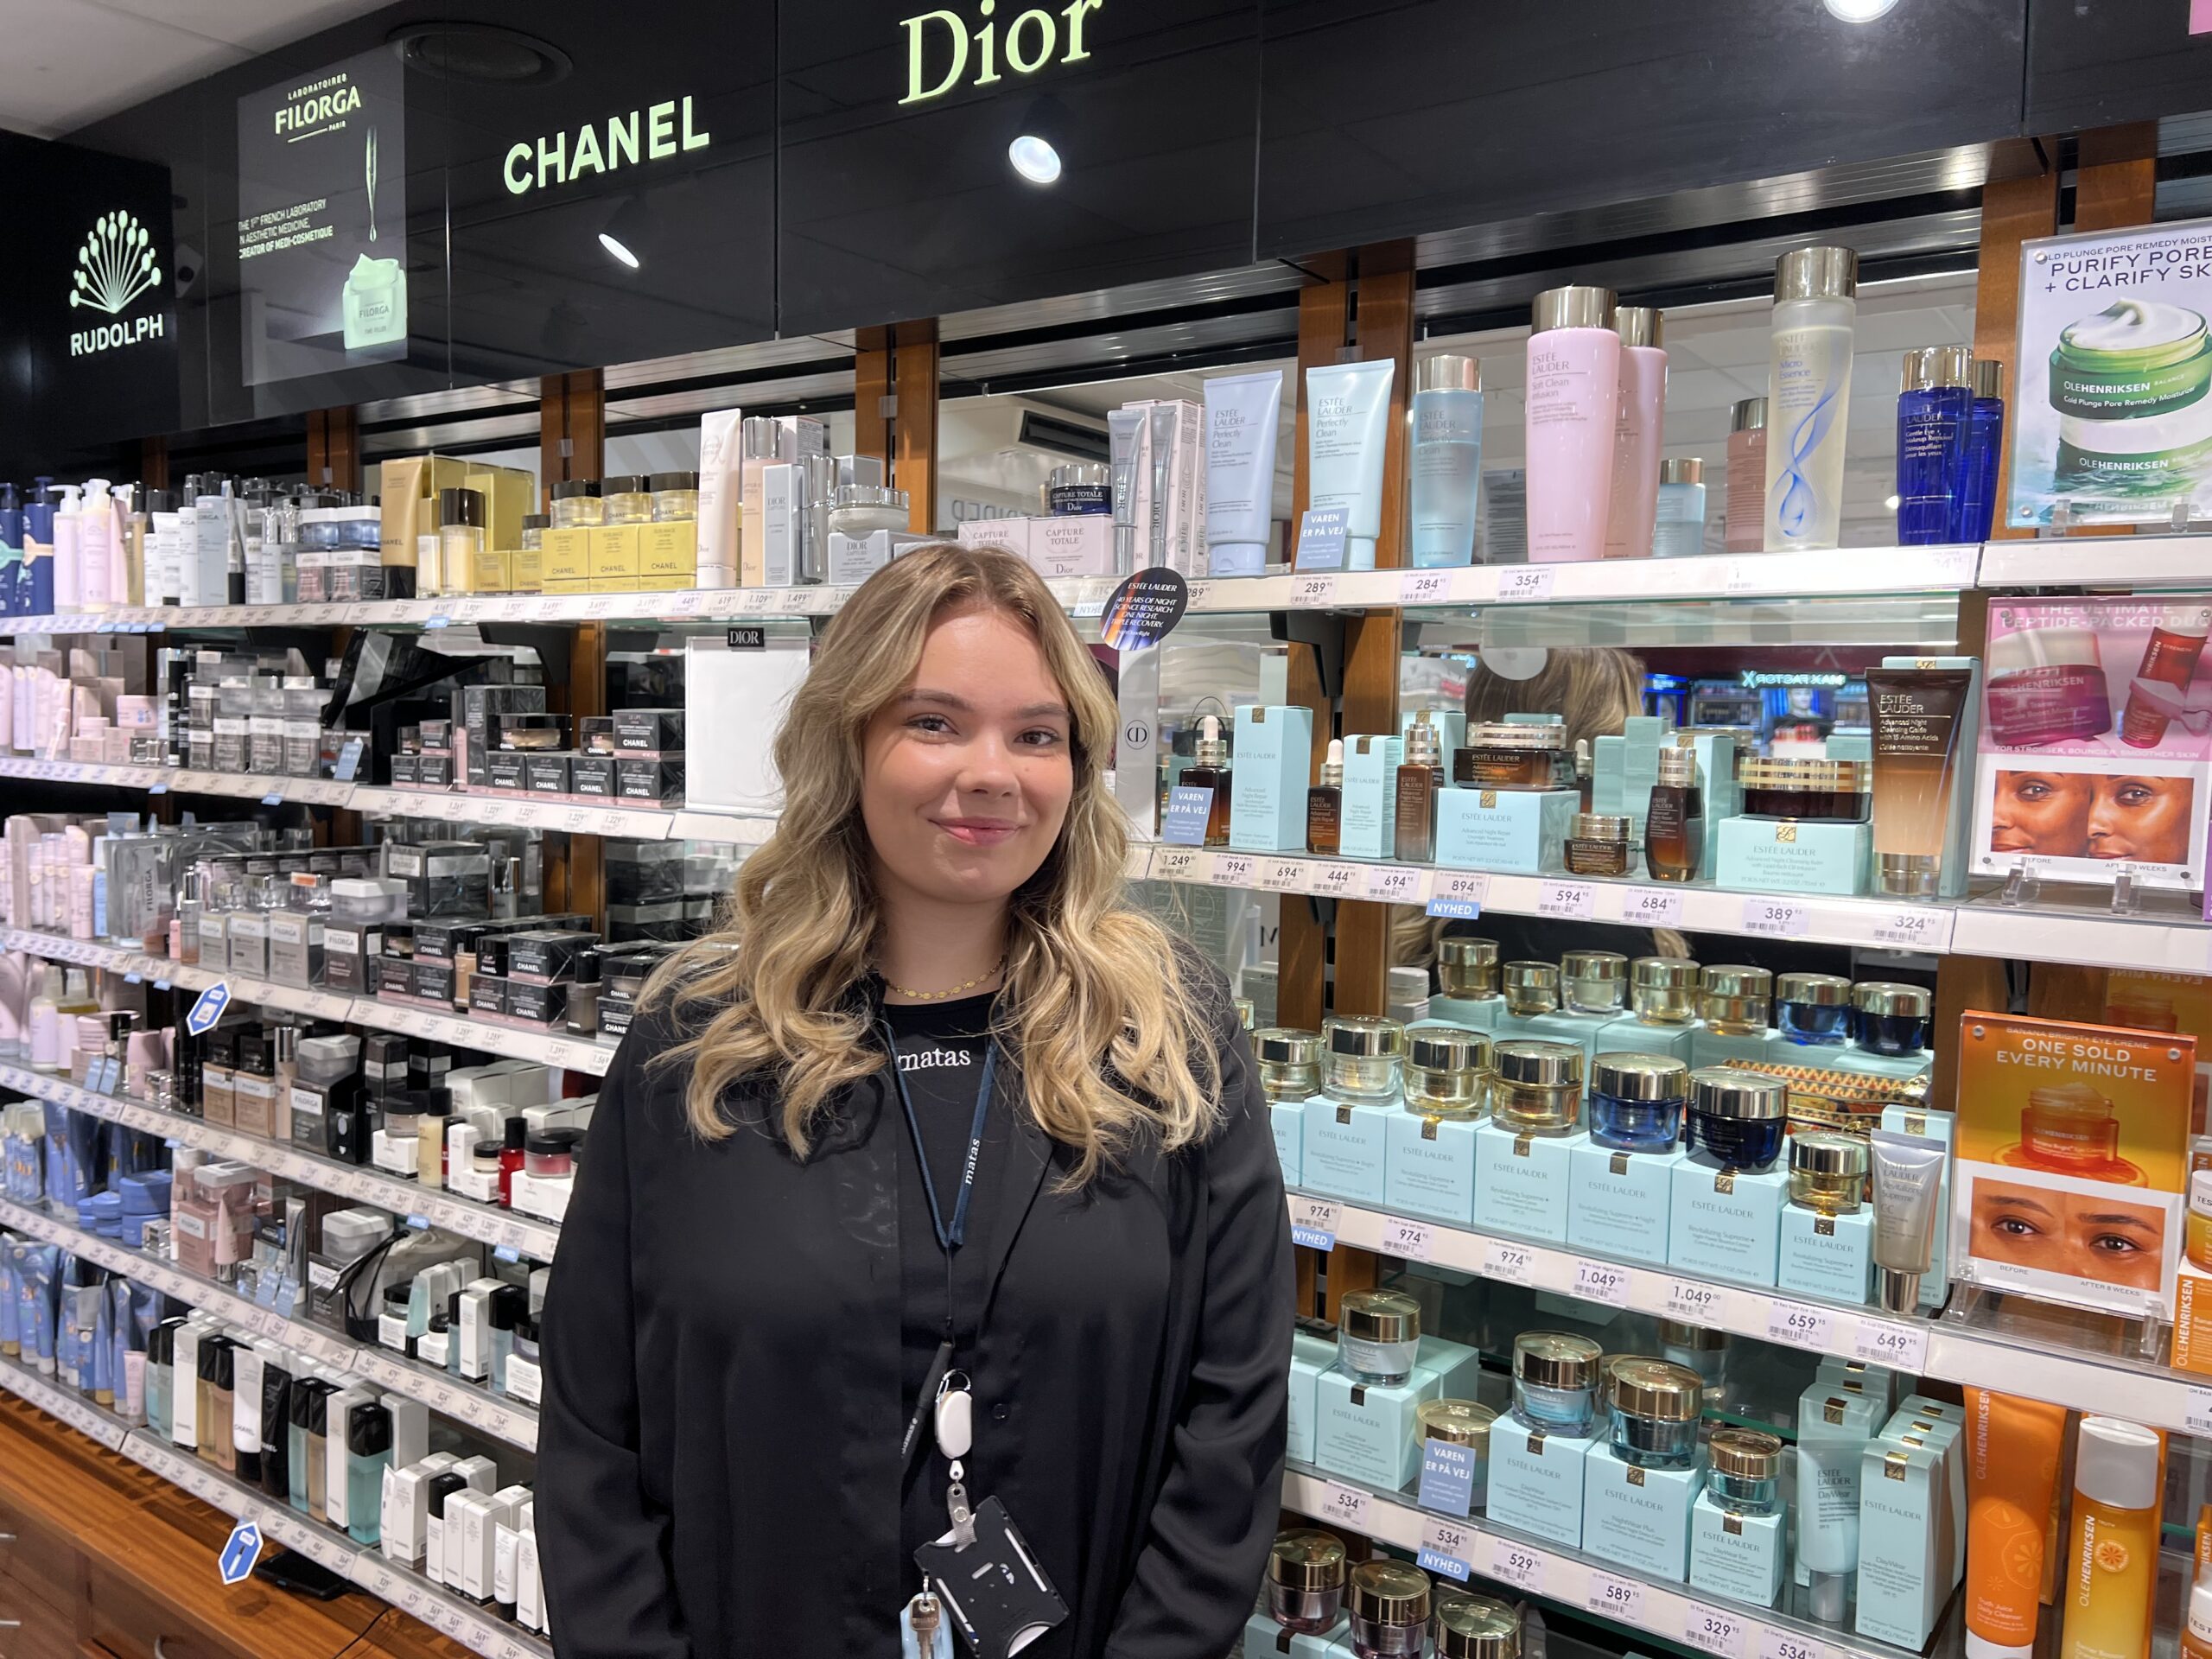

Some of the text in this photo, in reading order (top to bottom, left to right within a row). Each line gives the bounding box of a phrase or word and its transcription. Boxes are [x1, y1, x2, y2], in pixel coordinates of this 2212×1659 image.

[898, 0, 1103, 105] Dior
[288, 73, 347, 100] LABORATOIRES
[275, 86, 361, 134] FILORGA
[504, 96, 710, 194] CHANEL
[266, 241, 274, 252] OF
[275, 226, 334, 250] MEDI-COSMETIQUE
[2063, 248, 2103, 258] PLUNGE
[2107, 245, 2133, 254] PORE
[2136, 239, 2178, 251] REMEDY
[2051, 253, 2140, 276] PURIFY
[2065, 267, 2171, 291] CLARIFY
[359, 304, 390, 319] FILORGA
[70, 314, 163, 356] RUDOLPH
[2063, 396, 2077, 404] Cold
[2078, 397, 2102, 409] Plunge
[2125, 397, 2158, 407] Remedy
[2158, 385, 2196, 402] Moisturizer
[1318, 405, 1352, 416] LAUDER
[1214, 416, 1245, 427] LAUDER
[1317, 417, 1348, 429] Perfectly
[1213, 429, 1242, 439] Perfectly
[1315, 429, 1337, 438] Clean
[1211, 439, 1231, 448] Clean
[2079, 457, 2168, 471] OLEHENRIKSEN
[767, 496, 786, 506] DIOR
[1311, 513, 1339, 524] VAREN
[974, 531, 1009, 539] CAPTURE
[1046, 528, 1084, 537] CAPTURE
[1302, 526, 1344, 537] ER PÅ VEJ
[847, 542, 868, 550] DIOR
[1051, 536, 1079, 545] TOTALE
[651, 562, 677, 570] CHANEL
[1056, 563, 1073, 575] Dior
[1148, 583, 1177, 592] LAUDER
[1305, 582, 1326, 593] 289
[1415, 579, 1438, 590] 284
[1515, 575, 1540, 588] 354
[1140, 604, 1173, 613] RESEARCH
[2039, 604, 2174, 615] THE ULTIMATE
[2001, 616, 2210, 628] PEPTIDE-PACKED DUO
[729, 631, 760, 645] DIOR
[1879, 694, 1913, 704] ESTÉE
[1878, 704, 1924, 714] LAUDER
[623, 738, 648, 747] CHANEL
[495, 778, 516, 787] CHANEL
[536, 781, 558, 791] CHANEL
[580, 784, 603, 793] CHANEL
[626, 787, 650, 796] CHANEL
[1179, 792, 1204, 802] VAREN
[1462, 812, 1512, 822] ESTÉE LAUDER
[1754, 846, 1816, 856] ESTÉE LAUDER
[1227, 861, 1245, 873] 994
[1277, 867, 1297, 878] 694
[1327, 870, 1349, 882] 444
[1384, 876, 1407, 887] 694
[1452, 881, 1474, 892] 894
[1556, 890, 1581, 902] 594
[1433, 902, 1472, 915] NYHED
[1641, 897, 1668, 910] 684
[1764, 907, 1794, 920] 389
[1895, 916, 1925, 931] 324
[274, 926, 297, 937] FILORGA
[328, 936, 355, 946] FILORGA
[421, 946, 442, 956] CHANEL
[518, 963, 540, 973] CHANEL
[385, 982, 405, 991] CHANEL
[421, 988, 442, 998] CHANEL
[476, 1000, 498, 1009] CHANEL
[516, 1008, 537, 1018] CHANEL
[2022, 1039, 2131, 1062] ONE SOLD
[898, 1048, 971, 1071] matas
[1997, 1050, 2157, 1082] EVERY MINUTE
[1402, 1147, 1454, 1162] ESTÉE LAUDER
[965, 1138, 981, 1185] matas
[1493, 1162, 1548, 1179] ESTÉE LAUDER
[1588, 1181, 1646, 1198] ESTÉE LAUDER
[1310, 1205, 1330, 1218] 974
[1692, 1200, 1754, 1219] ESTÉE LAUDER
[1880, 1203, 1895, 1215] CC
[1293, 1230, 1327, 1246] NYHED
[1400, 1229, 1421, 1243] 974
[1794, 1235, 1853, 1253] ESTÉE LAUDER
[1501, 1250, 1524, 1266] 974
[1999, 1265, 2029, 1274] BEFORE
[1580, 1269, 1617, 1287] 1.049
[1673, 1286, 1712, 1304] 1.049
[2081, 1281, 2107, 1290] AFTER
[2113, 1287, 2141, 1297] WEEKS
[1789, 1313, 1816, 1329] 659
[2176, 1279, 2194, 1367] OLEHENRIKSEN
[1878, 1332, 1907, 1350] 649
[1433, 1446, 1465, 1464] VAREN
[1426, 1460, 1470, 1480] ER PÅ VEJ
[1507, 1458, 1561, 1480] ESTÉE LAUDER
[1817, 1468, 1841, 1478] ESTÉE
[1817, 1477, 1851, 1486] LAUDER
[1605, 1488, 1664, 1512] ESTÉE LAUDER
[1817, 1489, 1851, 1499] DayWear
[1338, 1493, 1359, 1510] 534
[1865, 1499, 1923, 1522] ESTÉE LAUDER
[1437, 1529, 1460, 1548] 534
[1703, 1531, 1760, 1553] ESTÉE LAUDER
[1424, 1553, 1463, 1574] NYHED
[1509, 1553, 1533, 1571] 529
[2079, 1515, 2095, 1607] OLEHENRIKSEN
[1606, 1585, 1631, 1603] 589
[1704, 1618, 1732, 1637] 329
